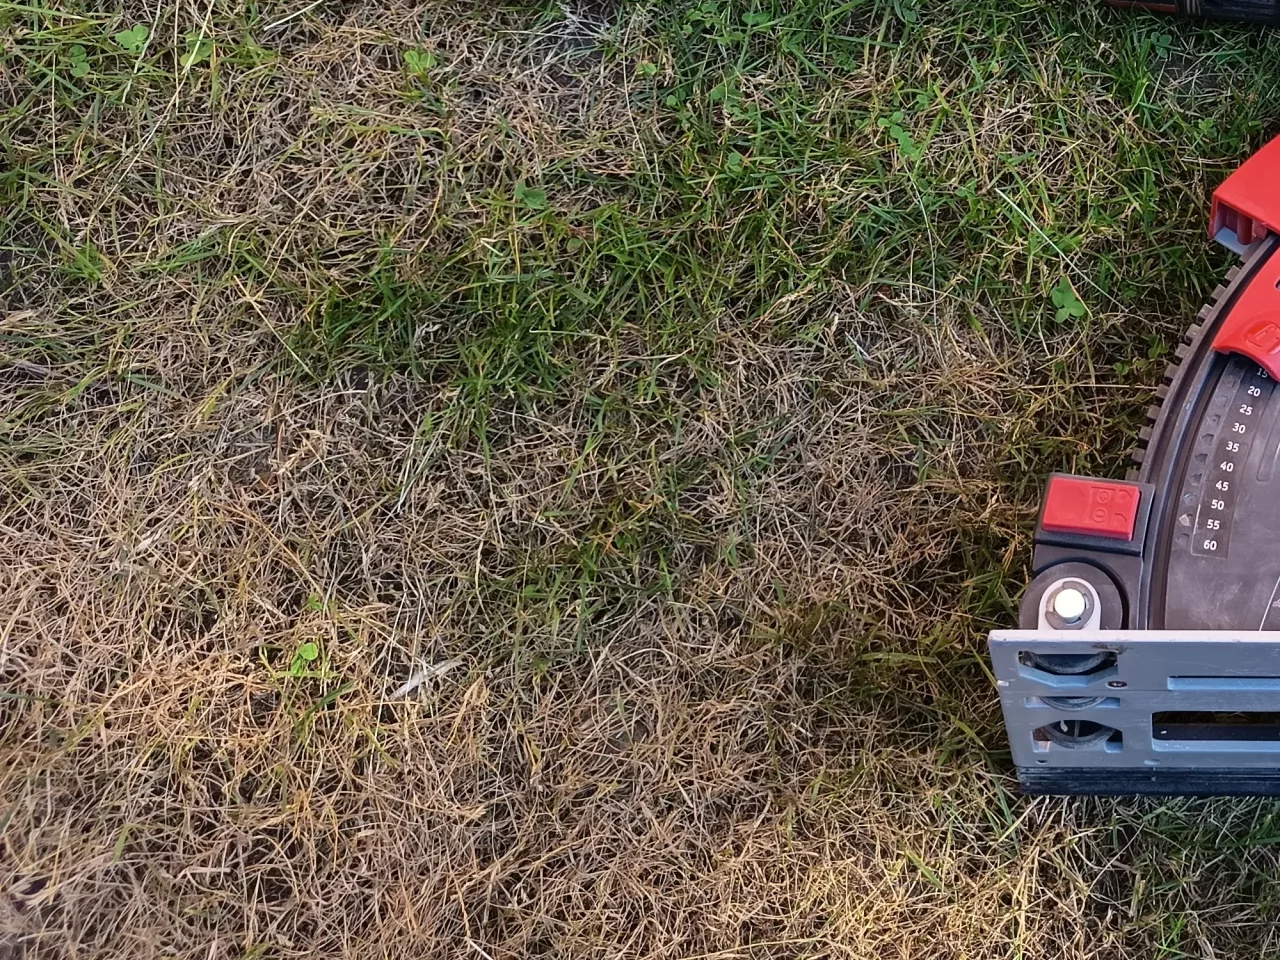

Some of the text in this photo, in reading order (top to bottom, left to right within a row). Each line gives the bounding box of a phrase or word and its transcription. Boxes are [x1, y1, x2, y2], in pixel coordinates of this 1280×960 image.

[1256, 367, 1268, 378] 15
[1247, 385, 1261, 397] 20
[1239, 404, 1253, 416] 25
[1232, 422, 1246, 434] 30
[1225, 441, 1240, 453] 35
[1220, 461, 1234, 472] 40
[1215, 480, 1229, 491] 45
[1210, 499, 1225, 510] 50
[1206, 519, 1220, 530] 55
[1203, 540, 1217, 551] 60
